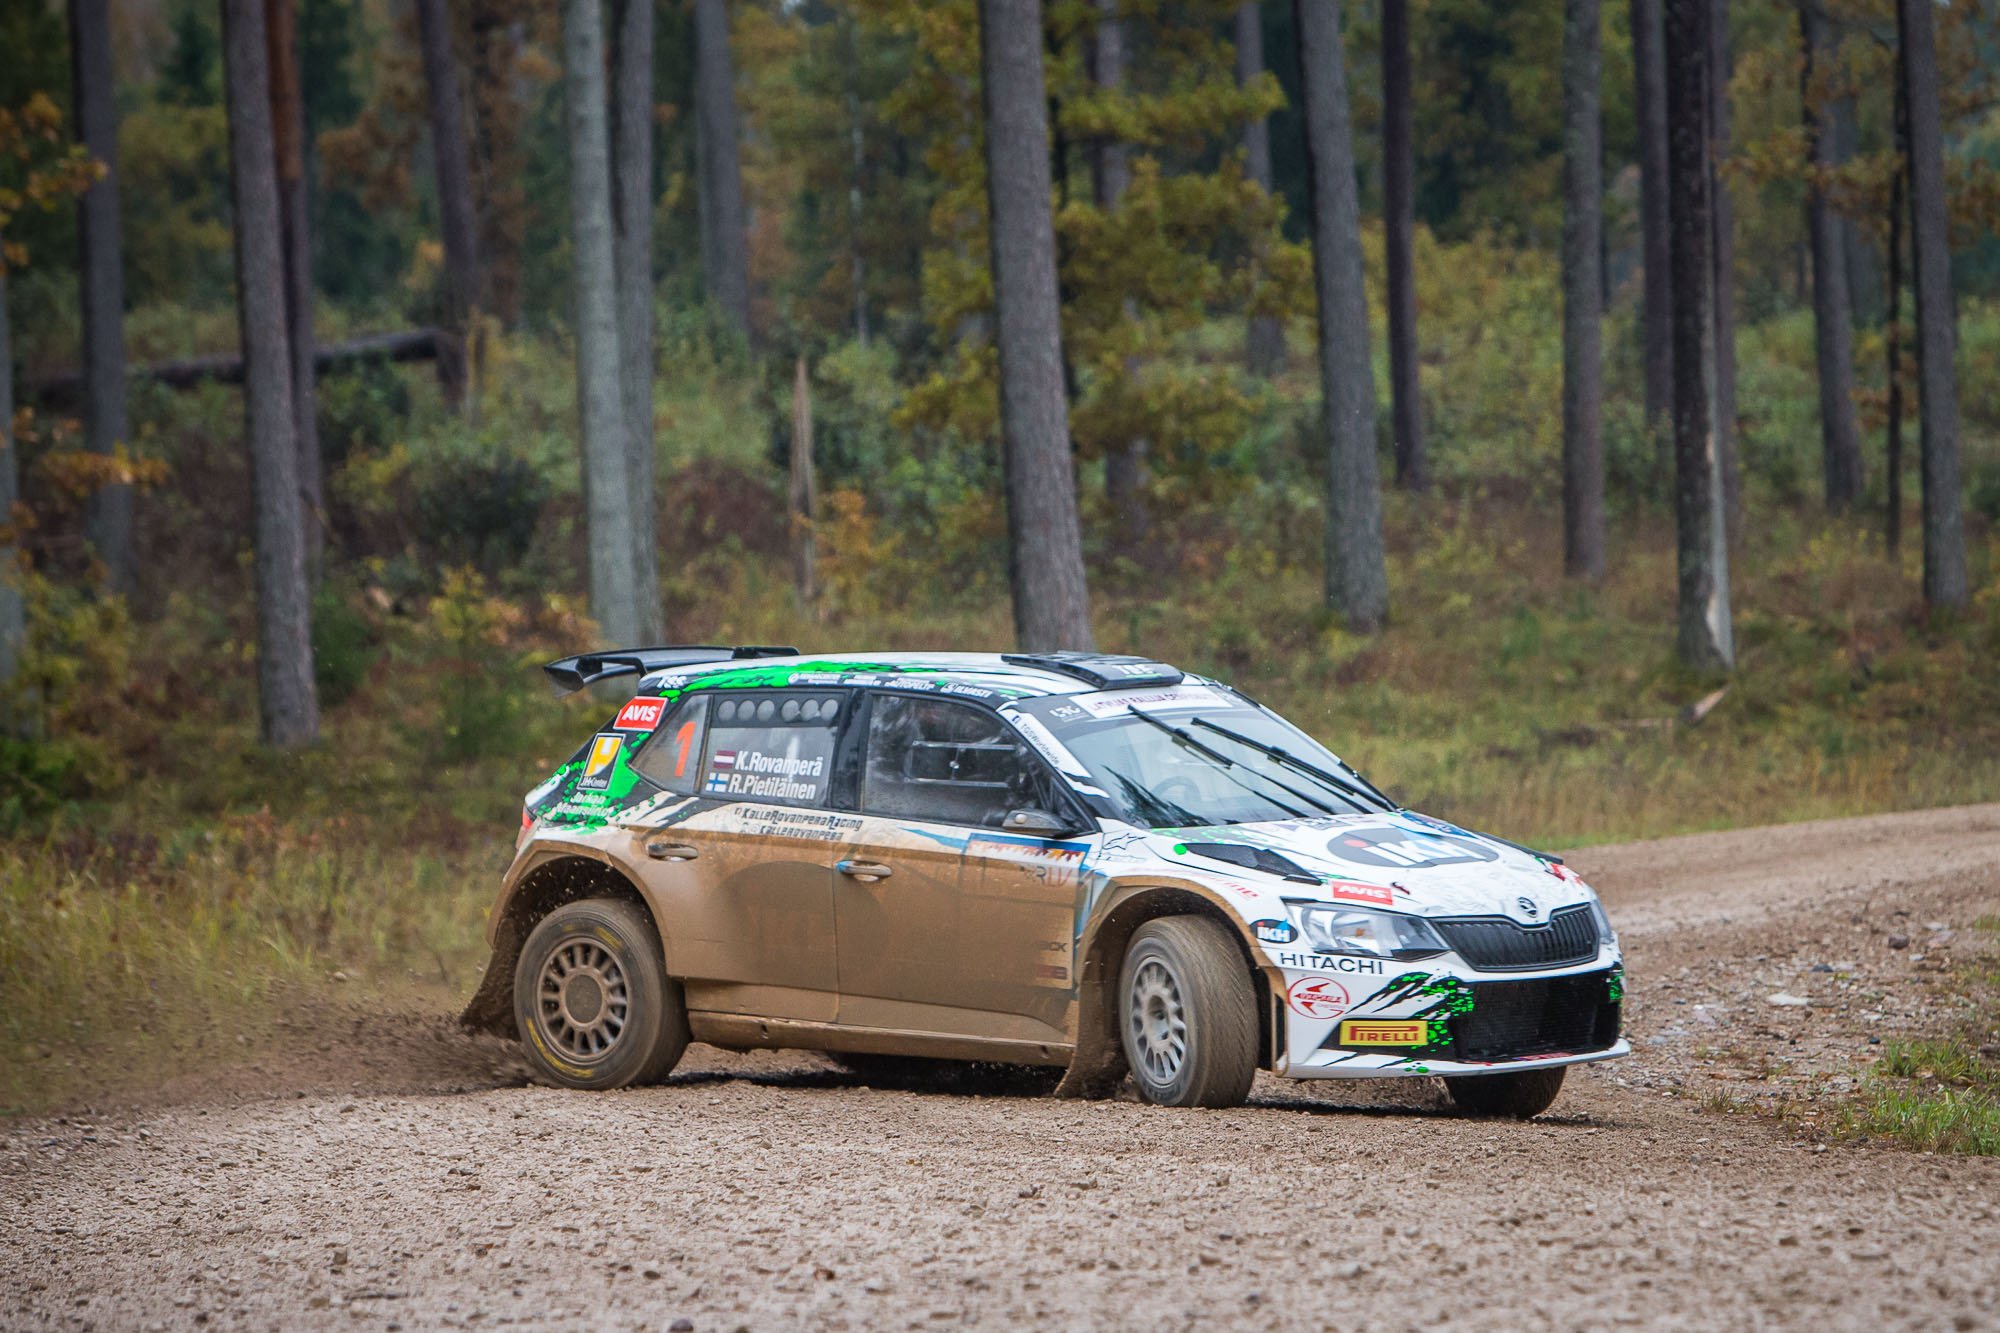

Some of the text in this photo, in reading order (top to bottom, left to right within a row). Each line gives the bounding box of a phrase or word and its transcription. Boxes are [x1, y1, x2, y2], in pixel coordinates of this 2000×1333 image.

[622, 704, 657, 723] AVIS
[674, 721, 697, 777] 1
[734, 750, 824, 777] K.Rovanperä
[727, 774, 817, 800] R.Pietiläinen
[1336, 883, 1388, 900] AVIS
[1279, 952, 1384, 975] HITACHI
[1348, 1023, 1420, 1044] PIRELLI
